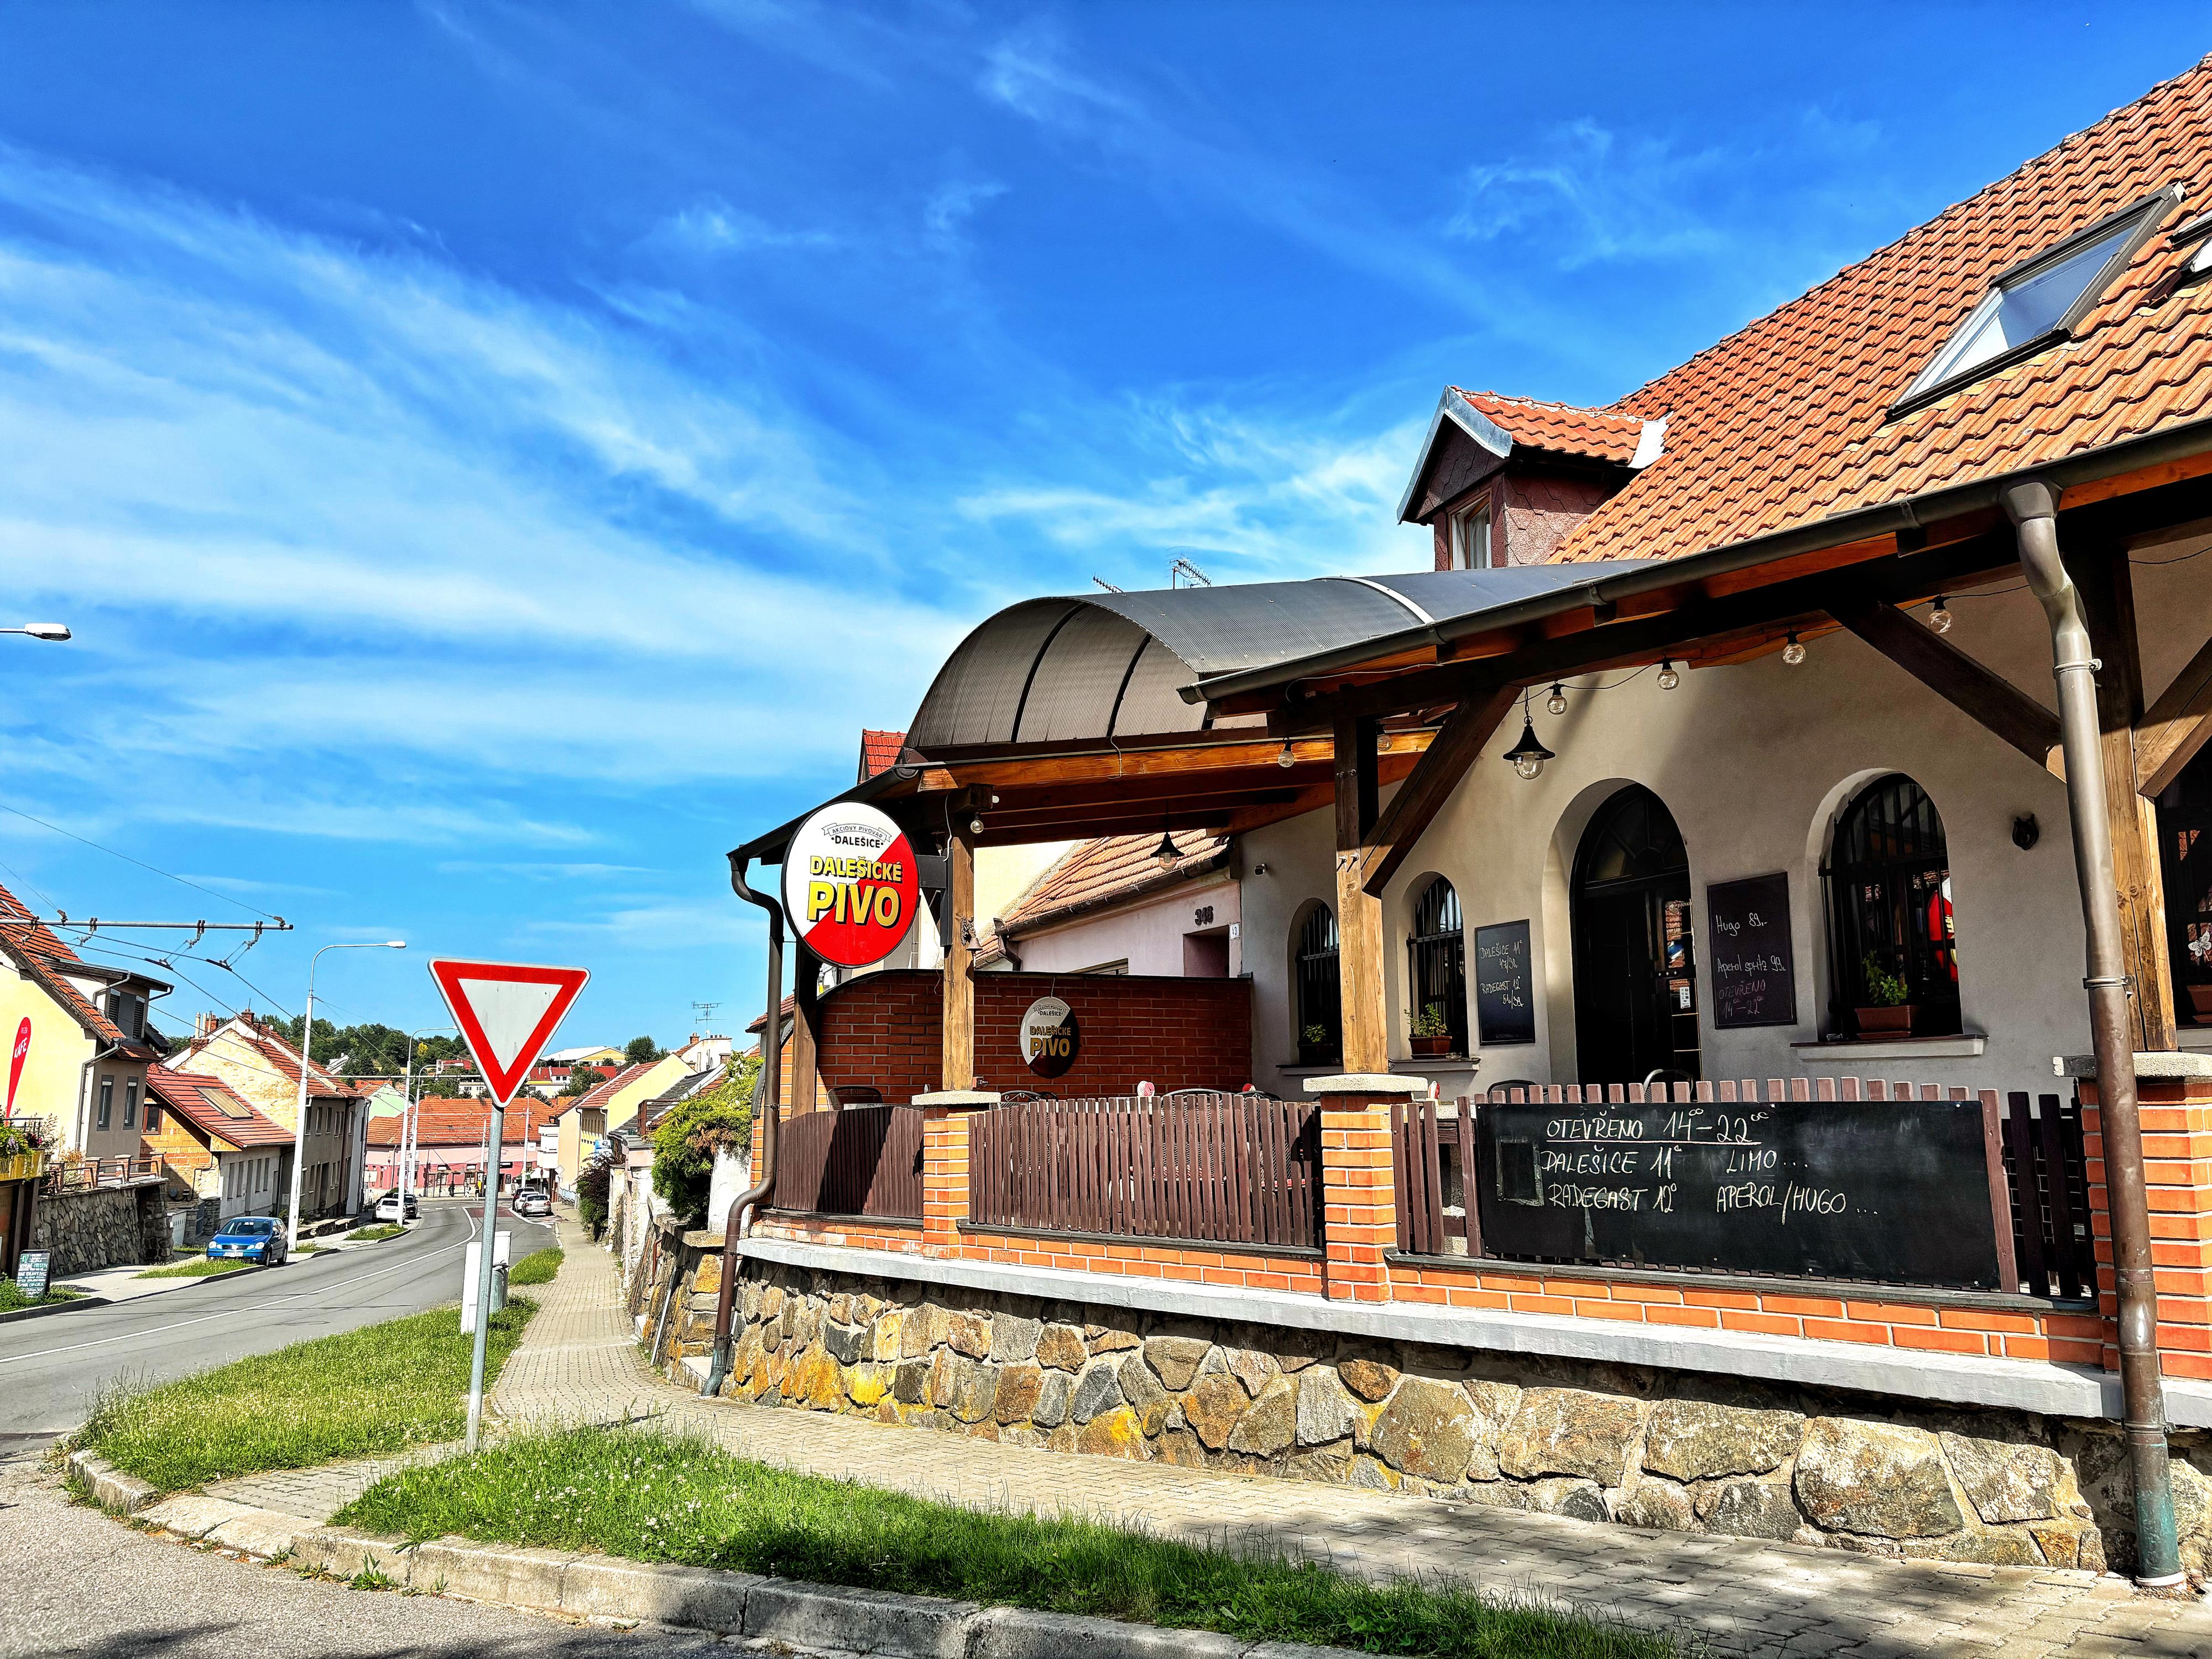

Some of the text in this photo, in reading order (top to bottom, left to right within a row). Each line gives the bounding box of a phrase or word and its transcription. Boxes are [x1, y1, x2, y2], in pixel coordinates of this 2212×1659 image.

[834, 835, 880, 848] DALEŠICE
[859, 826, 883, 838] PIVOVAR
[810, 855, 903, 884] DALEŠICKÉ
[807, 880, 902, 929] PIVO
[1715, 914, 1740, 936] Hugo
[1479, 942, 1510, 958] DALEŠICE
[1717, 954, 1742, 978] Aperol
[1745, 954, 1768, 977] spritz
[1480, 980, 1511, 994] RADEGAST
[1719, 979, 1766, 999] OTEVŘENO
[1030, 1025, 1071, 1036] DALEŠICKÉ
[1030, 1037, 1070, 1057] PIVO
[1547, 1110, 1644, 1139] OTEVŘENO
[1540, 1144, 1639, 1175] DALEŠICE
[1548, 1182, 1649, 1212] RADEGAST
